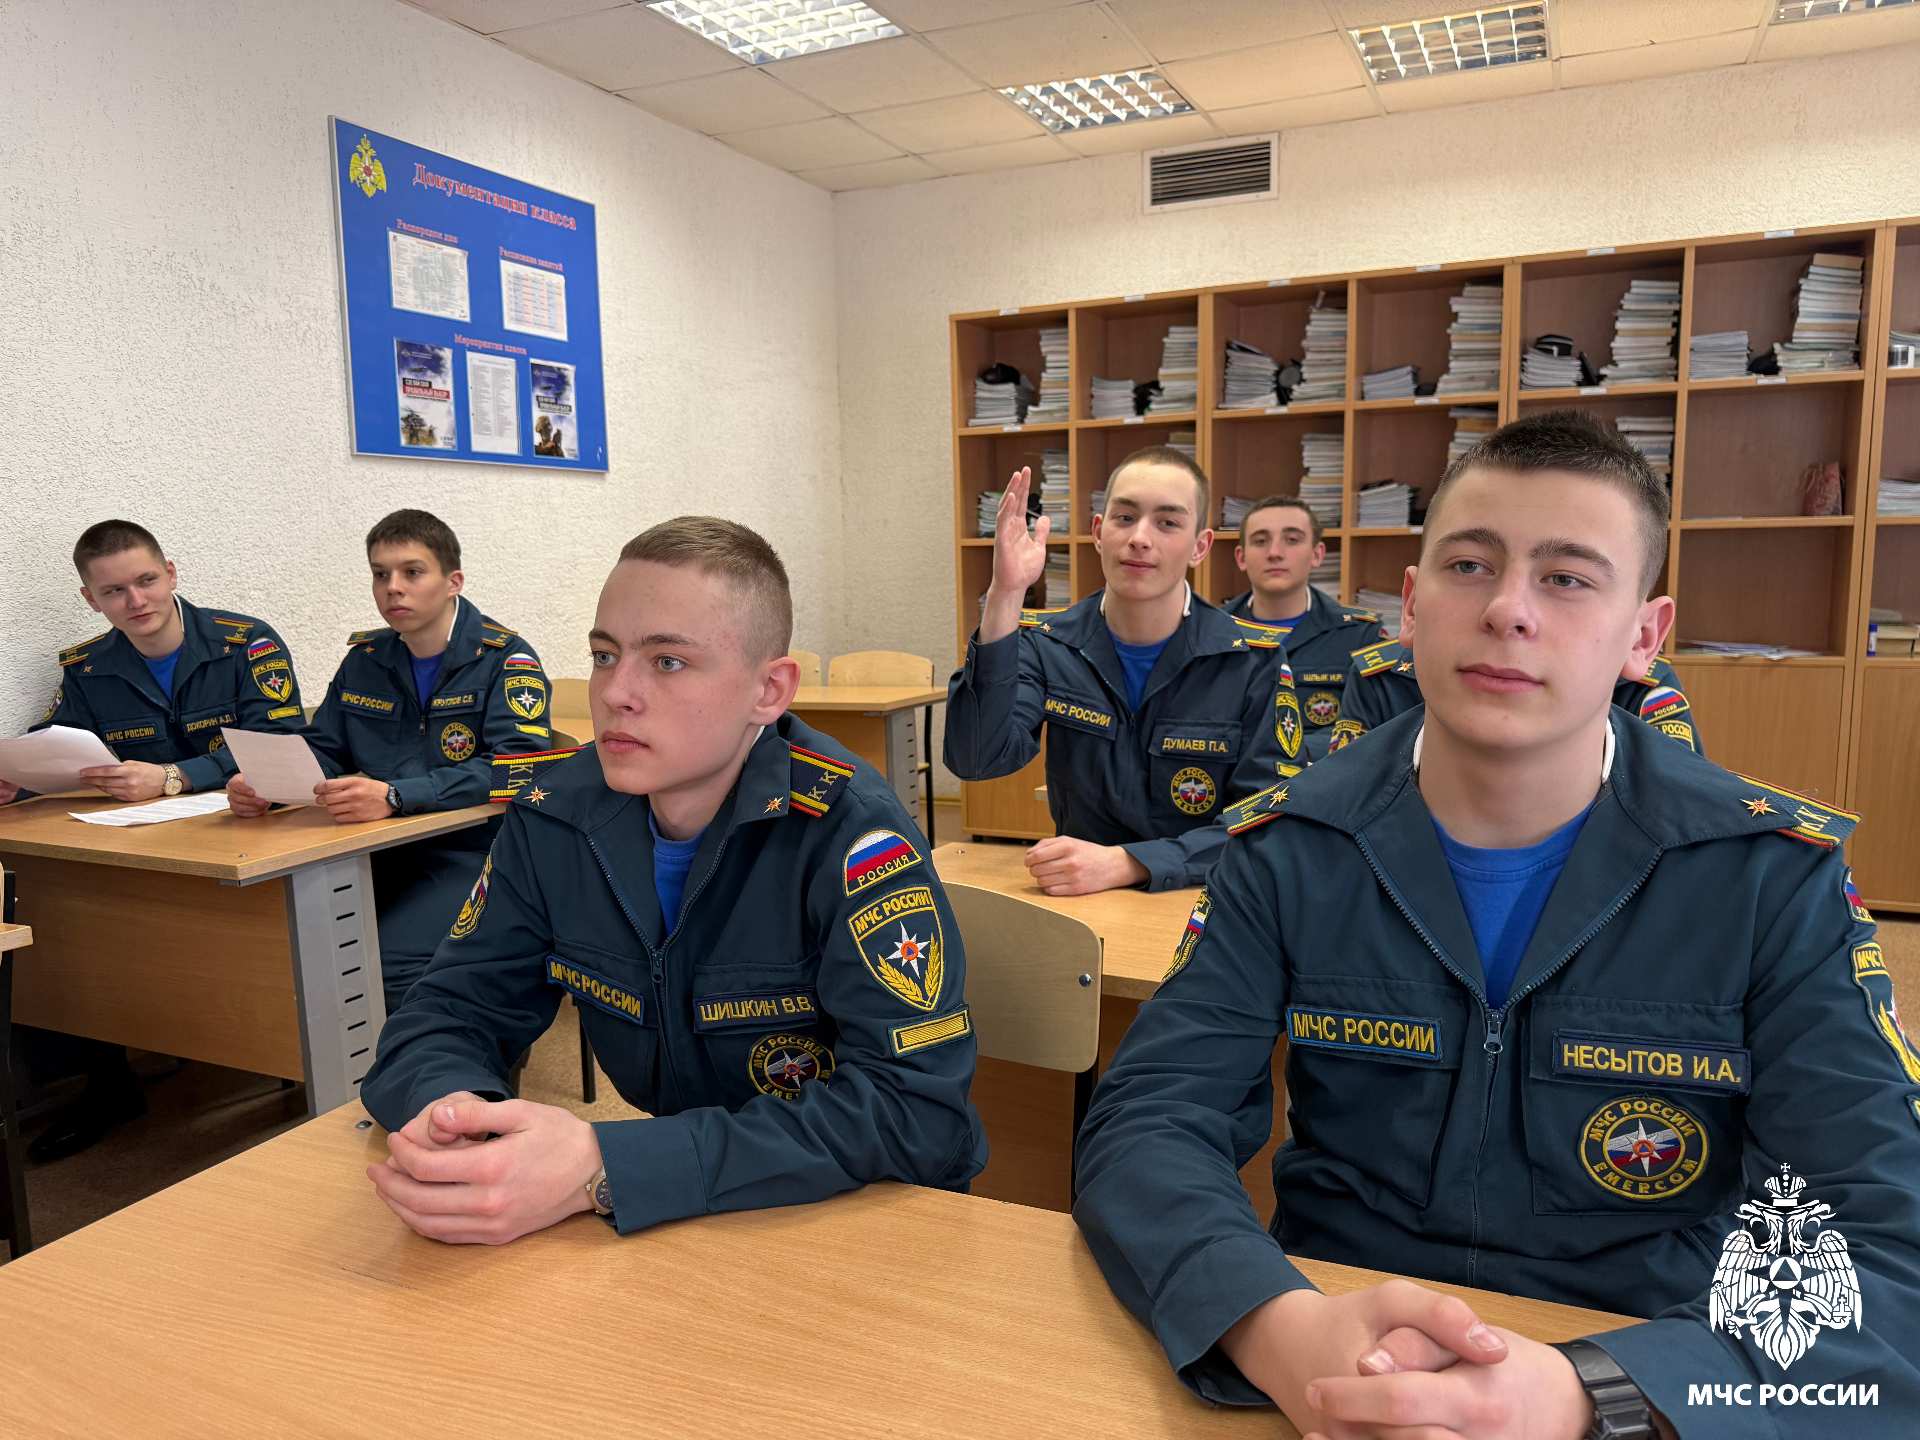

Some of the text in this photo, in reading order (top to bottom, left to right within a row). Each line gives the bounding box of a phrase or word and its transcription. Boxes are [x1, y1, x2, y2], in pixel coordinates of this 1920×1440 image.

[412, 163, 528, 216] Документация
[342, 692, 394, 712] МЧС РОССИИ
[1045, 699, 1111, 728] МЧС РОССИИ
[105, 727, 156, 742] МЧС РОССИИ
[1162, 738, 1229, 752] ДУМАЕВ П.А.
[857, 854, 911, 886] РОССИЯ
[853, 891, 931, 935] МЧС РОССИИ
[1857, 949, 1881, 969] МЧС
[550, 961, 642, 1018] МЧС РОССИИ
[700, 995, 816, 1022] ШИШКИН В.В.
[1293, 1012, 1435, 1053] МЧС РОССИИ
[1563, 1043, 1742, 1083] НЕСЫТОВ И.А.
[1589, 1100, 1697, 1142] МЧС РОССИИ
[1592, 1158, 1698, 1195] EMERCOM
